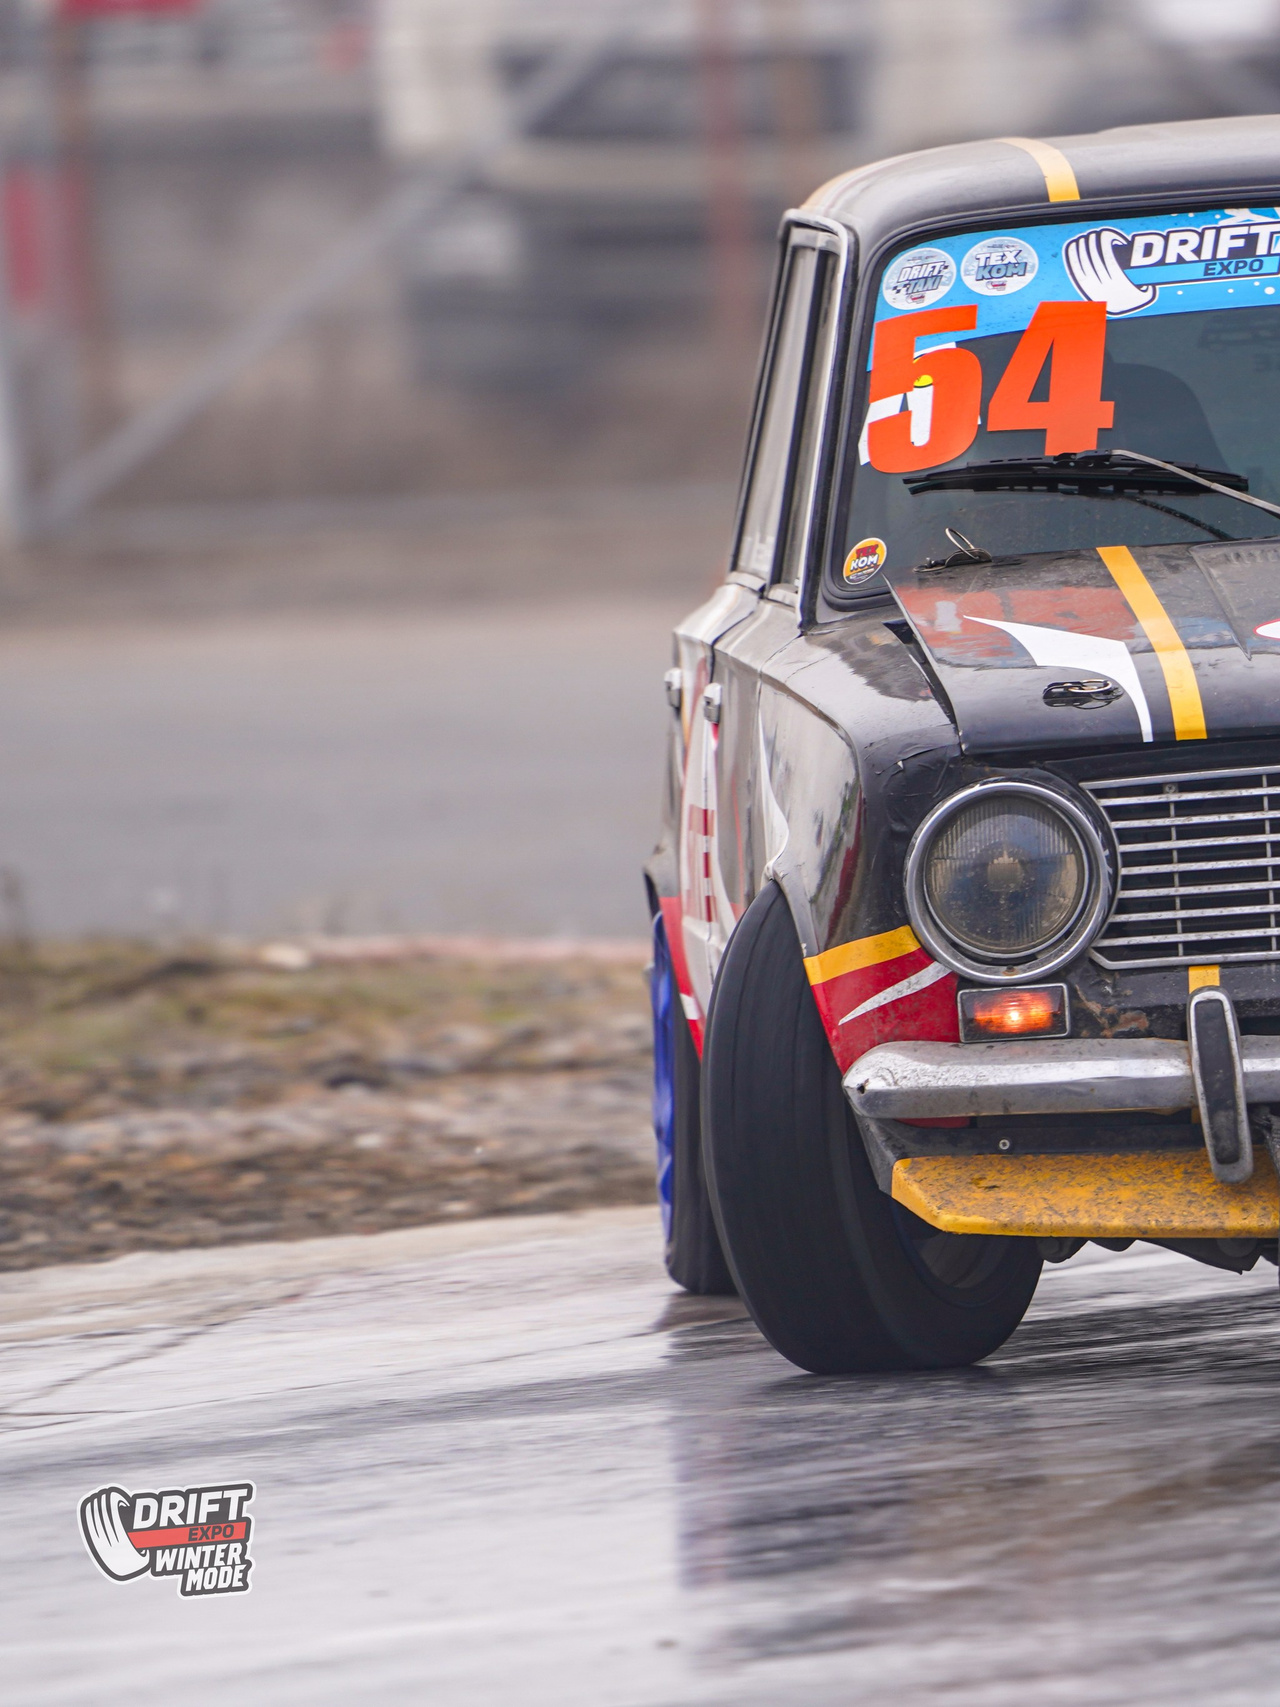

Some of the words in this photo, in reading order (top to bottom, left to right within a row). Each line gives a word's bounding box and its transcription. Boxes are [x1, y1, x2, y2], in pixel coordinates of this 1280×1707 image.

[896, 260, 946, 284] DRIFT
[1202, 258, 1265, 277] EXPO
[905, 275, 944, 296] TAXI
[867, 300, 1116, 474] 54
